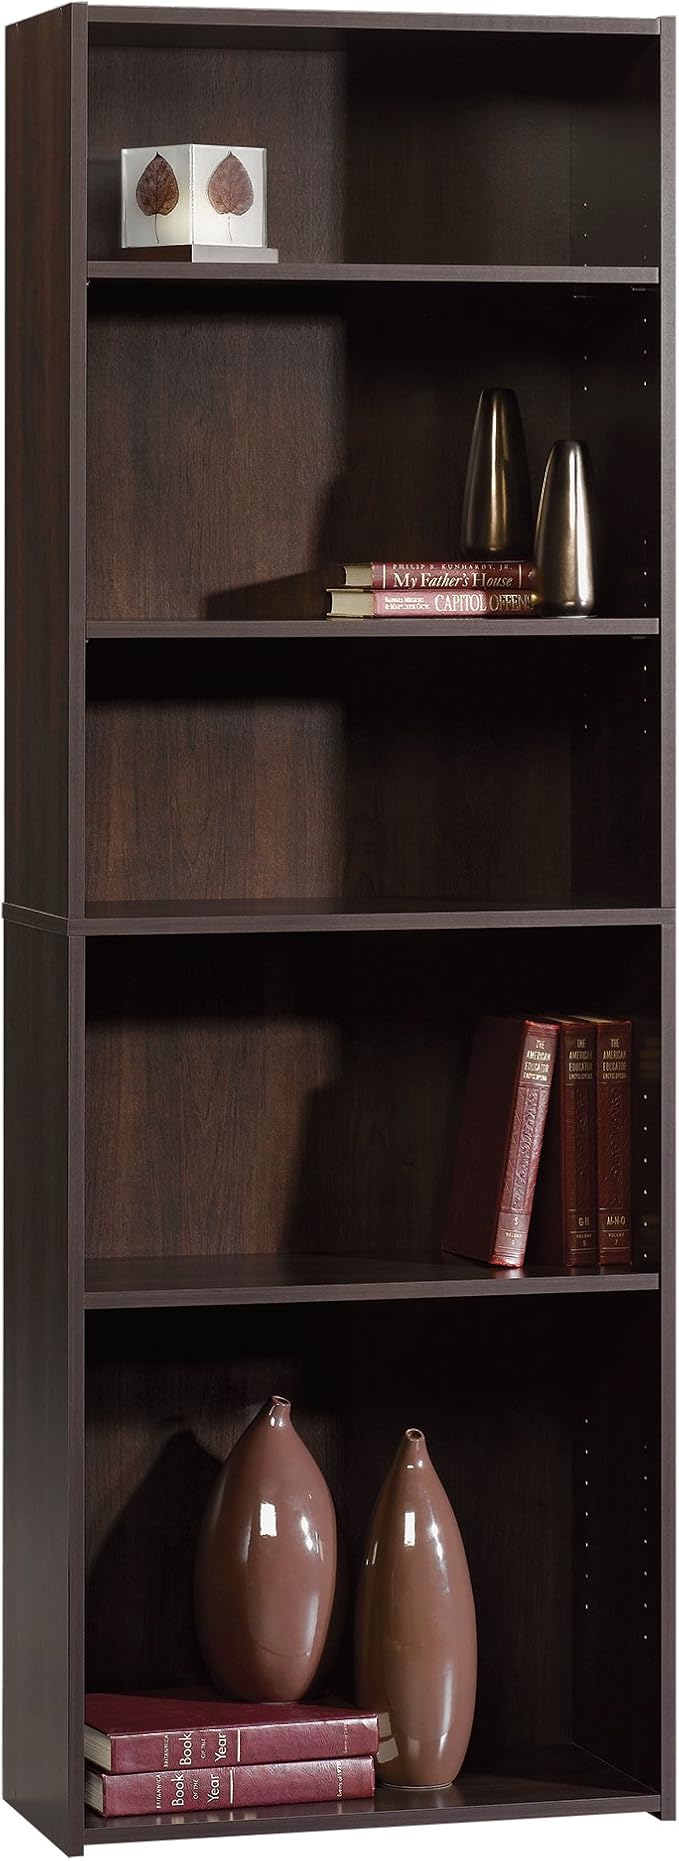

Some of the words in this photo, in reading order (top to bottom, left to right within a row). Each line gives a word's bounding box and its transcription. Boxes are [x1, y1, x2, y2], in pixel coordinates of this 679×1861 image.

[393, 572, 418, 589] My
[421, 571, 469, 588] Father's
[473, 572, 513, 587] House
[434, 594, 487, 612] CAPITOL
[536, 1039, 546, 1050] THE
[576, 1039, 586, 1048] THE
[609, 1038, 620, 1048] THE
[526, 1050, 552, 1062] AMERICAN
[602, 1050, 627, 1060] AMERICAN
[524, 1061, 550, 1073] EDUCATOR
[602, 1061, 627, 1072] EDUCATOR
[514, 1217, 519, 1225] S
[179, 1733, 191, 1765] Book
[215, 1733, 226, 1761] Year
[201, 1750, 206, 1759] OF
[171, 1774, 184, 1806] Book
[207, 1774, 219, 1802] Year
[193, 1791, 198, 1799] OF
